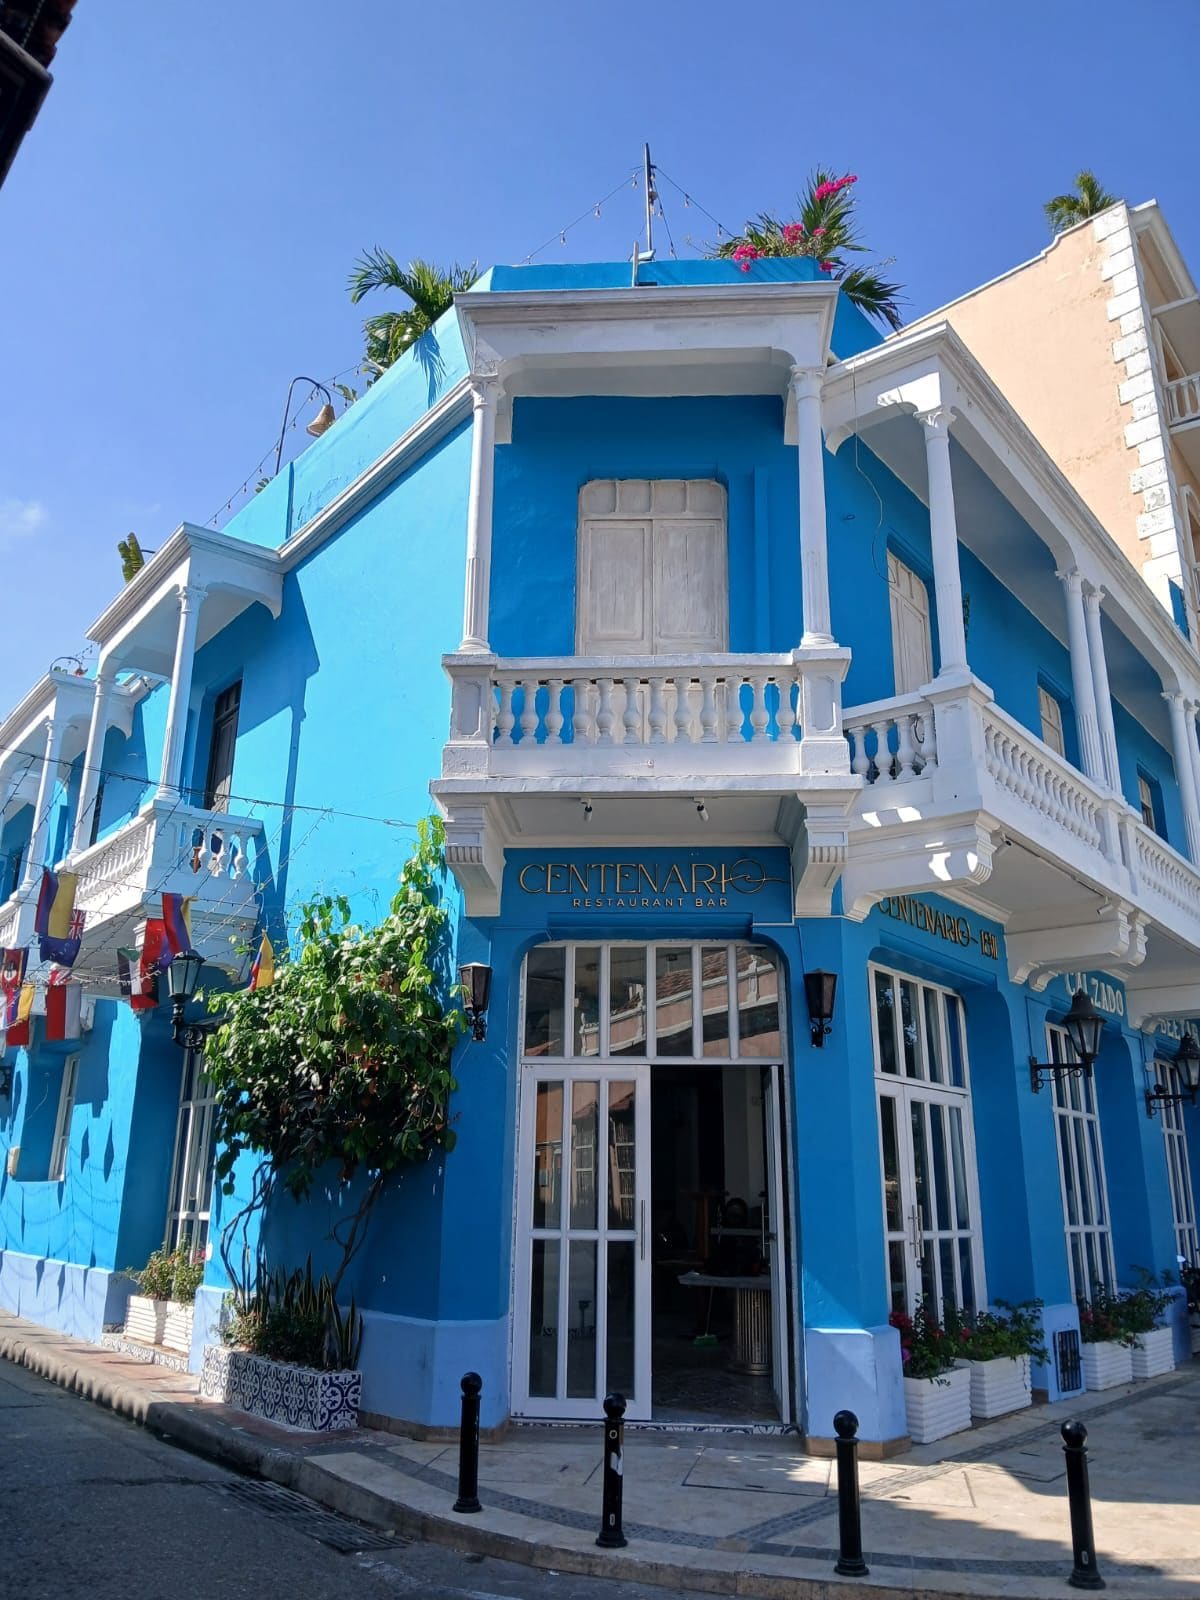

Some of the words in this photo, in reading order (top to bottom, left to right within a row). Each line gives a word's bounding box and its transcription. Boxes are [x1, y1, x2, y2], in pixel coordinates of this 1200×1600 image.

[519, 858, 767, 894] CENTENARIO
[573, 898, 684, 908] RESTAURANT
[695, 898, 728, 908] BAR
[878, 895, 971, 947] CENTENARIO
